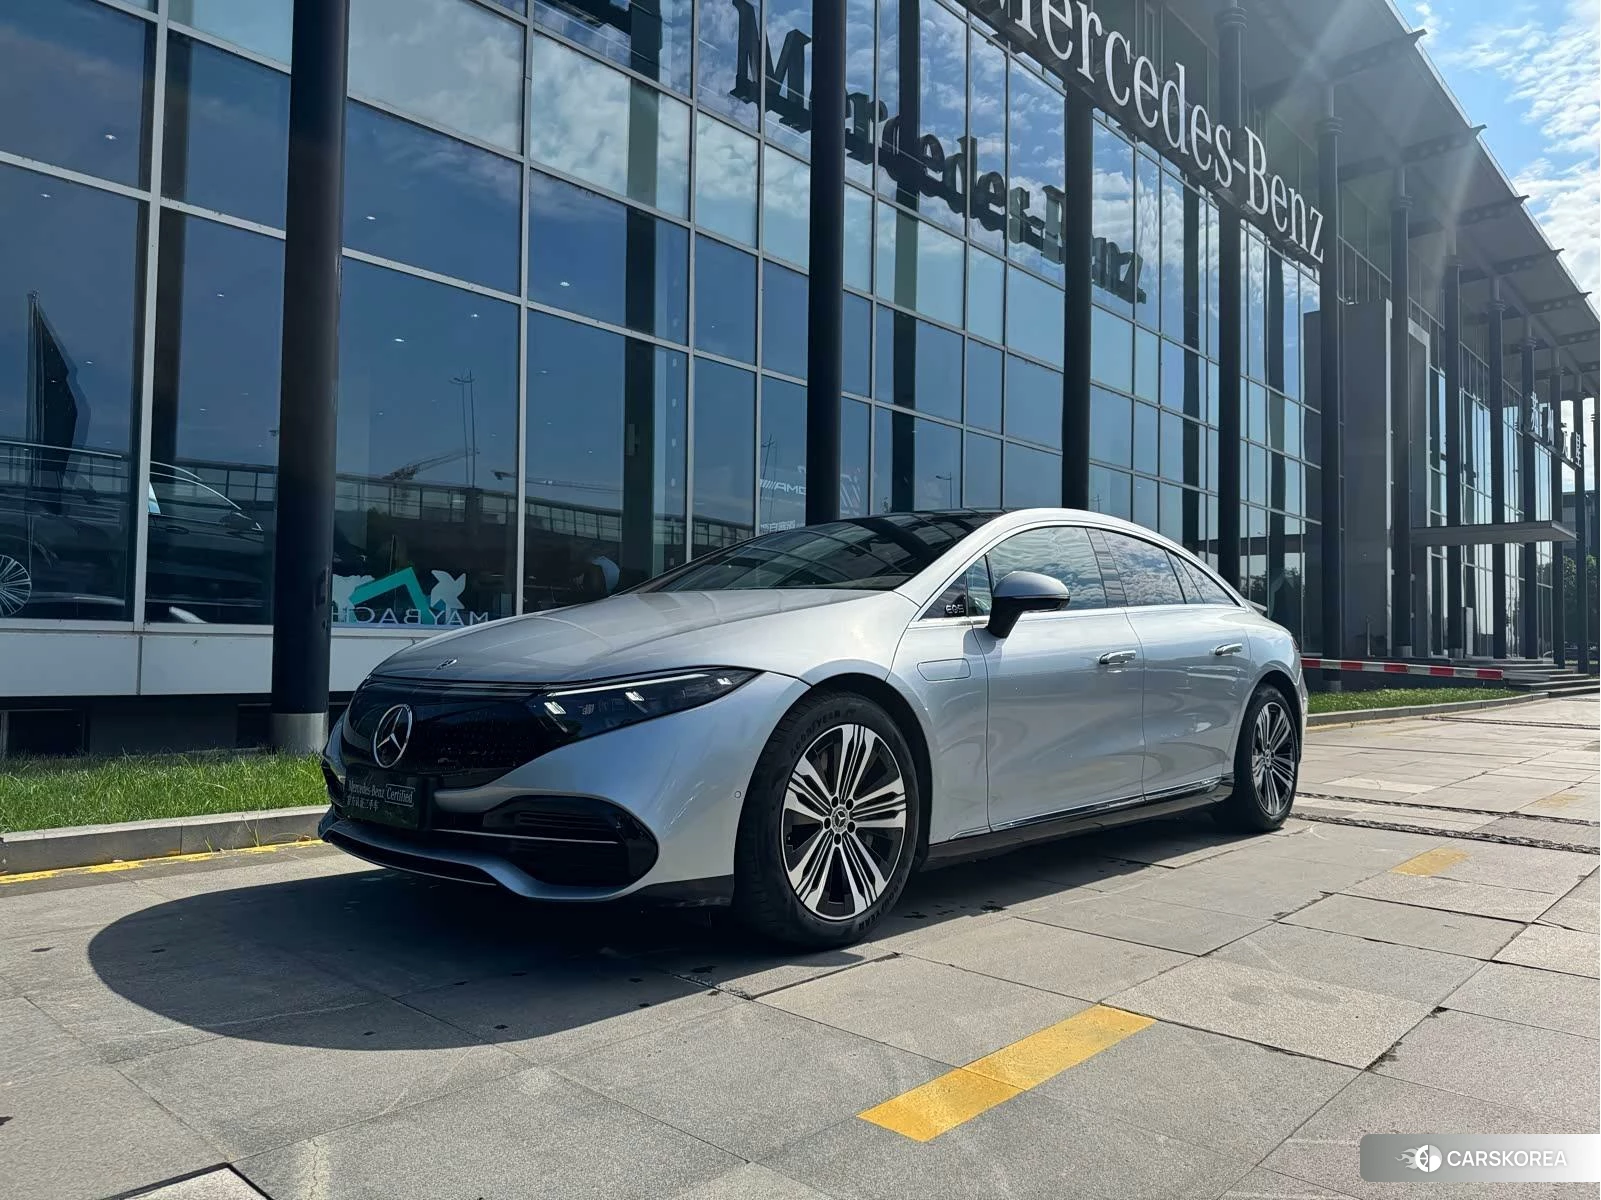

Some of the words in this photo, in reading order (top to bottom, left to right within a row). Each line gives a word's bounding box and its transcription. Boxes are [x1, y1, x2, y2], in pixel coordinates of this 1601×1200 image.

[729, 0, 1146, 304] Mrcedes-Bnz
[348, 780, 385, 799] Mercedes-Benz
[386, 787, 413, 804] Certified
